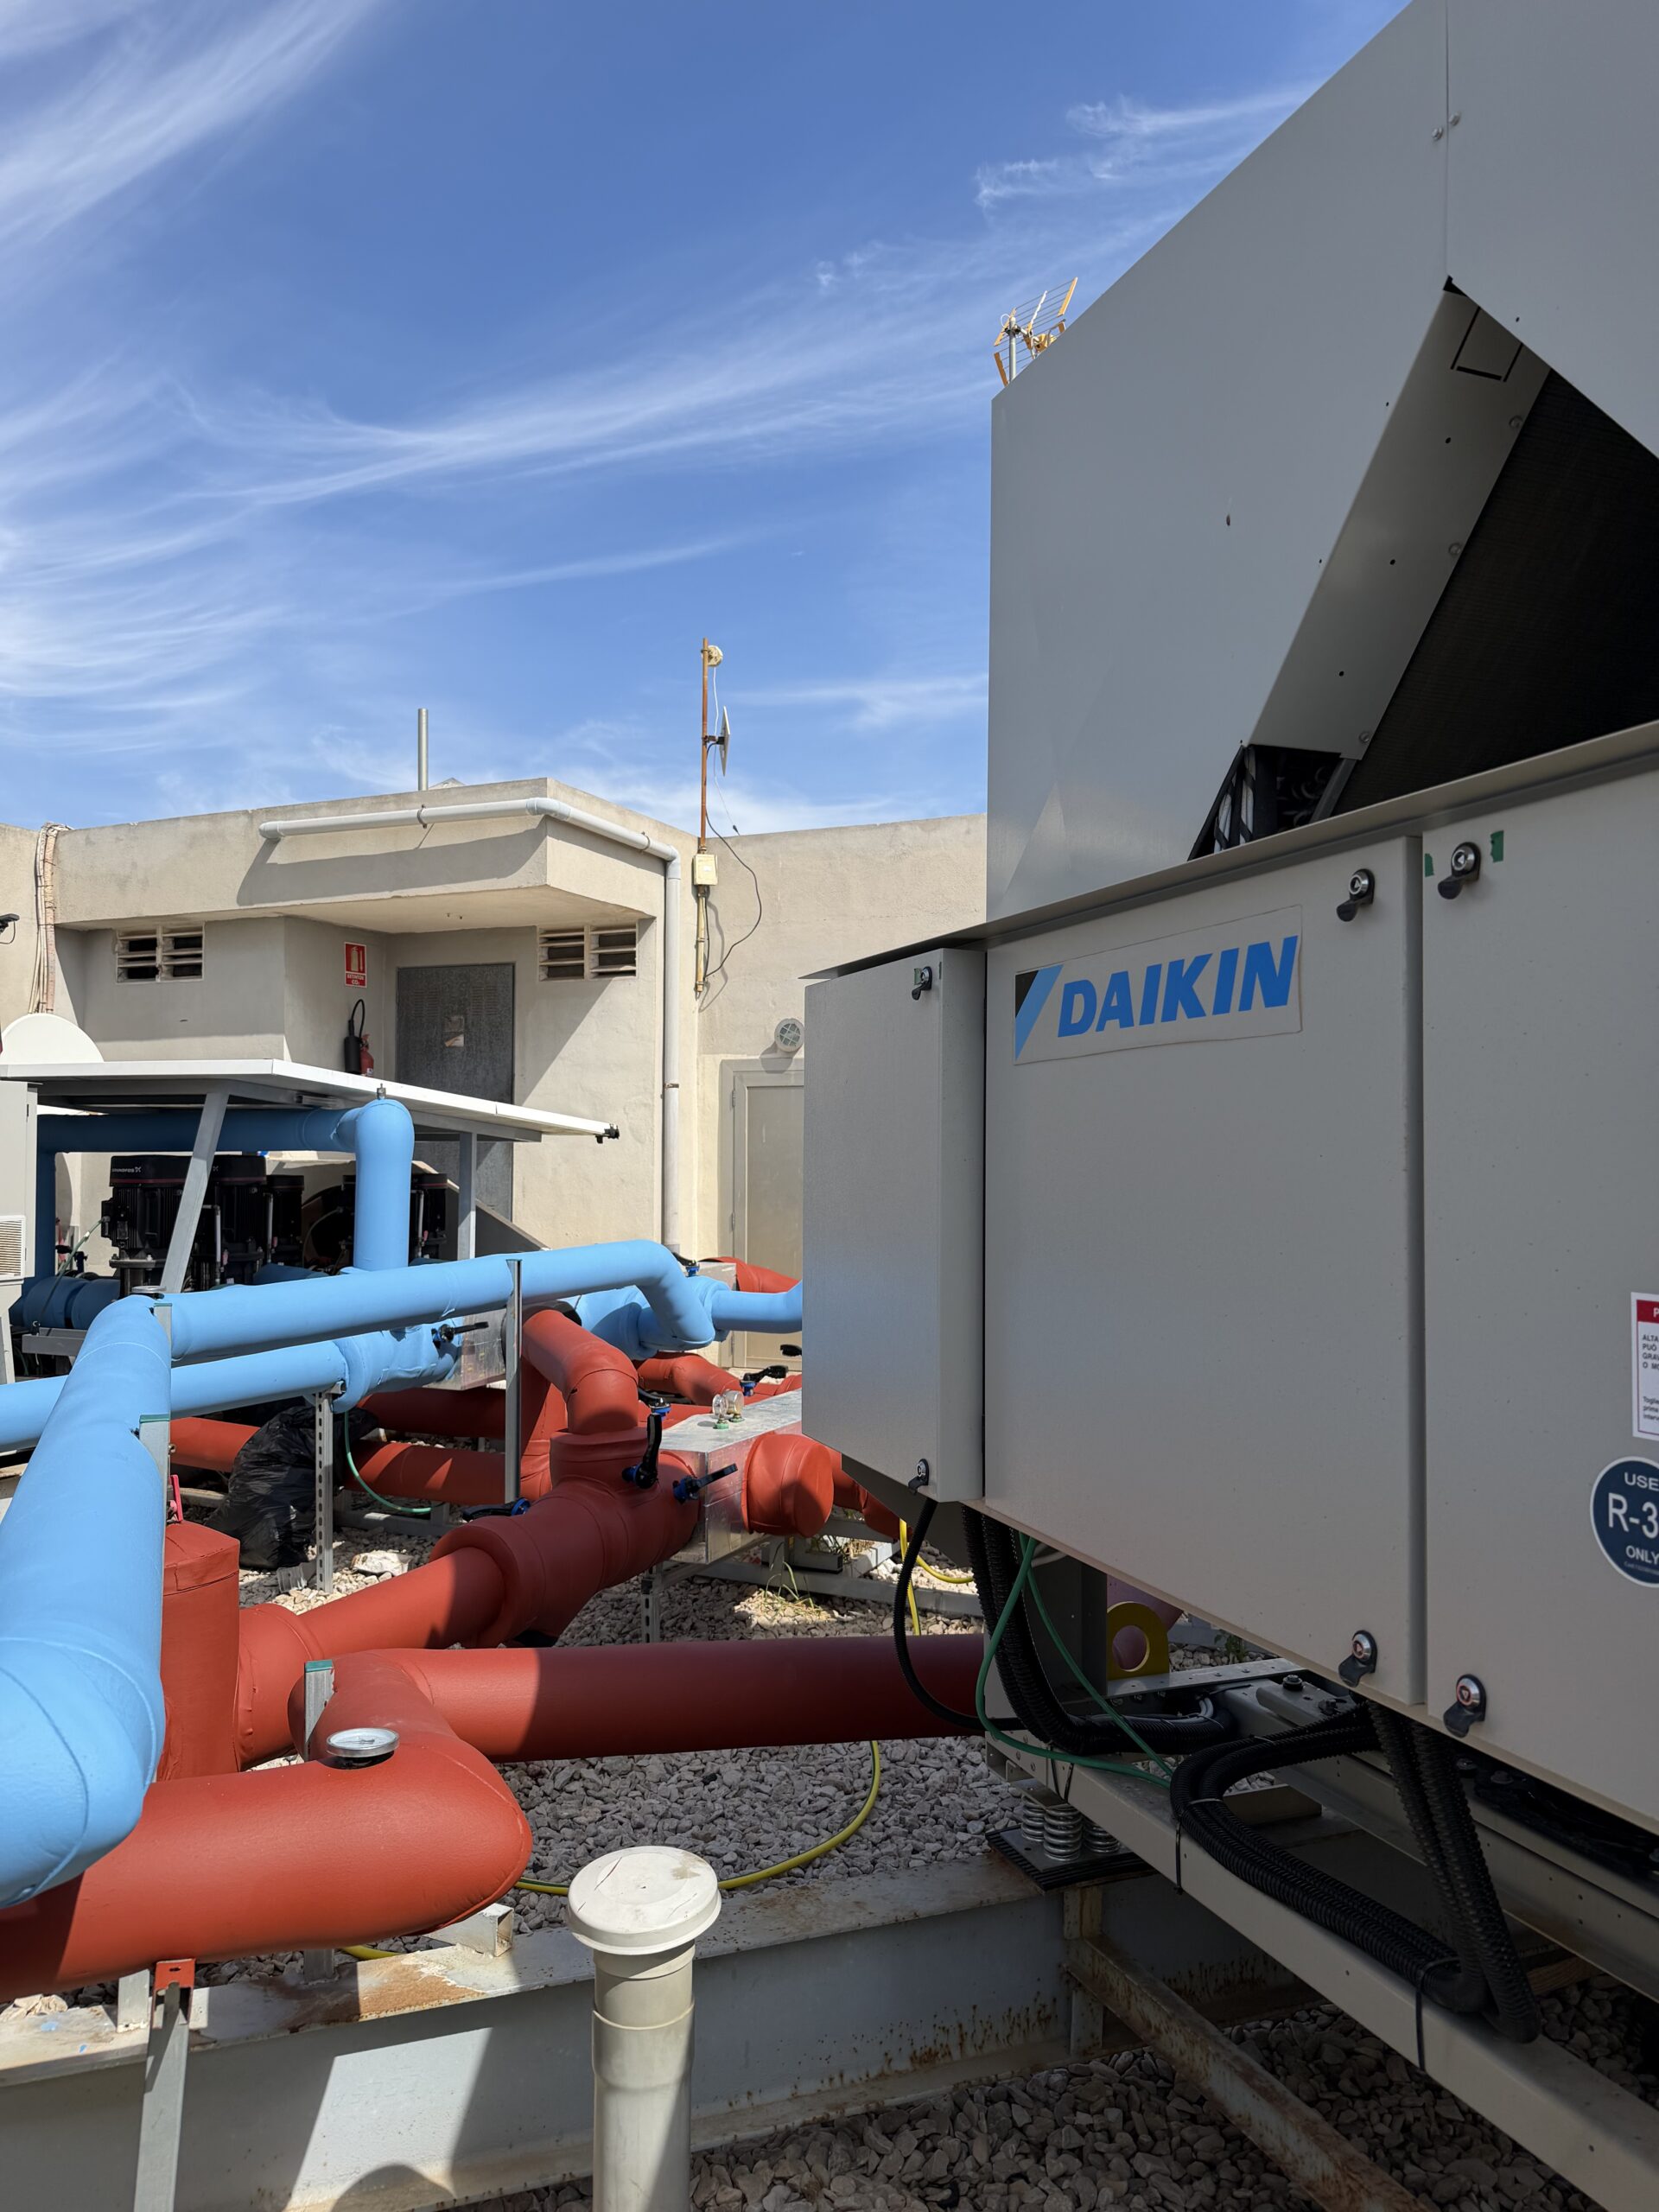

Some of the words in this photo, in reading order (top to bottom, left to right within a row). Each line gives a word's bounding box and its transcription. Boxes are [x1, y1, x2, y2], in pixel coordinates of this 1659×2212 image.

[1057, 935, 1299, 1038] DAIKIN
[1624, 1471, 1659, 1491] USE
[1625, 1545, 1659, 1566] ONLY
